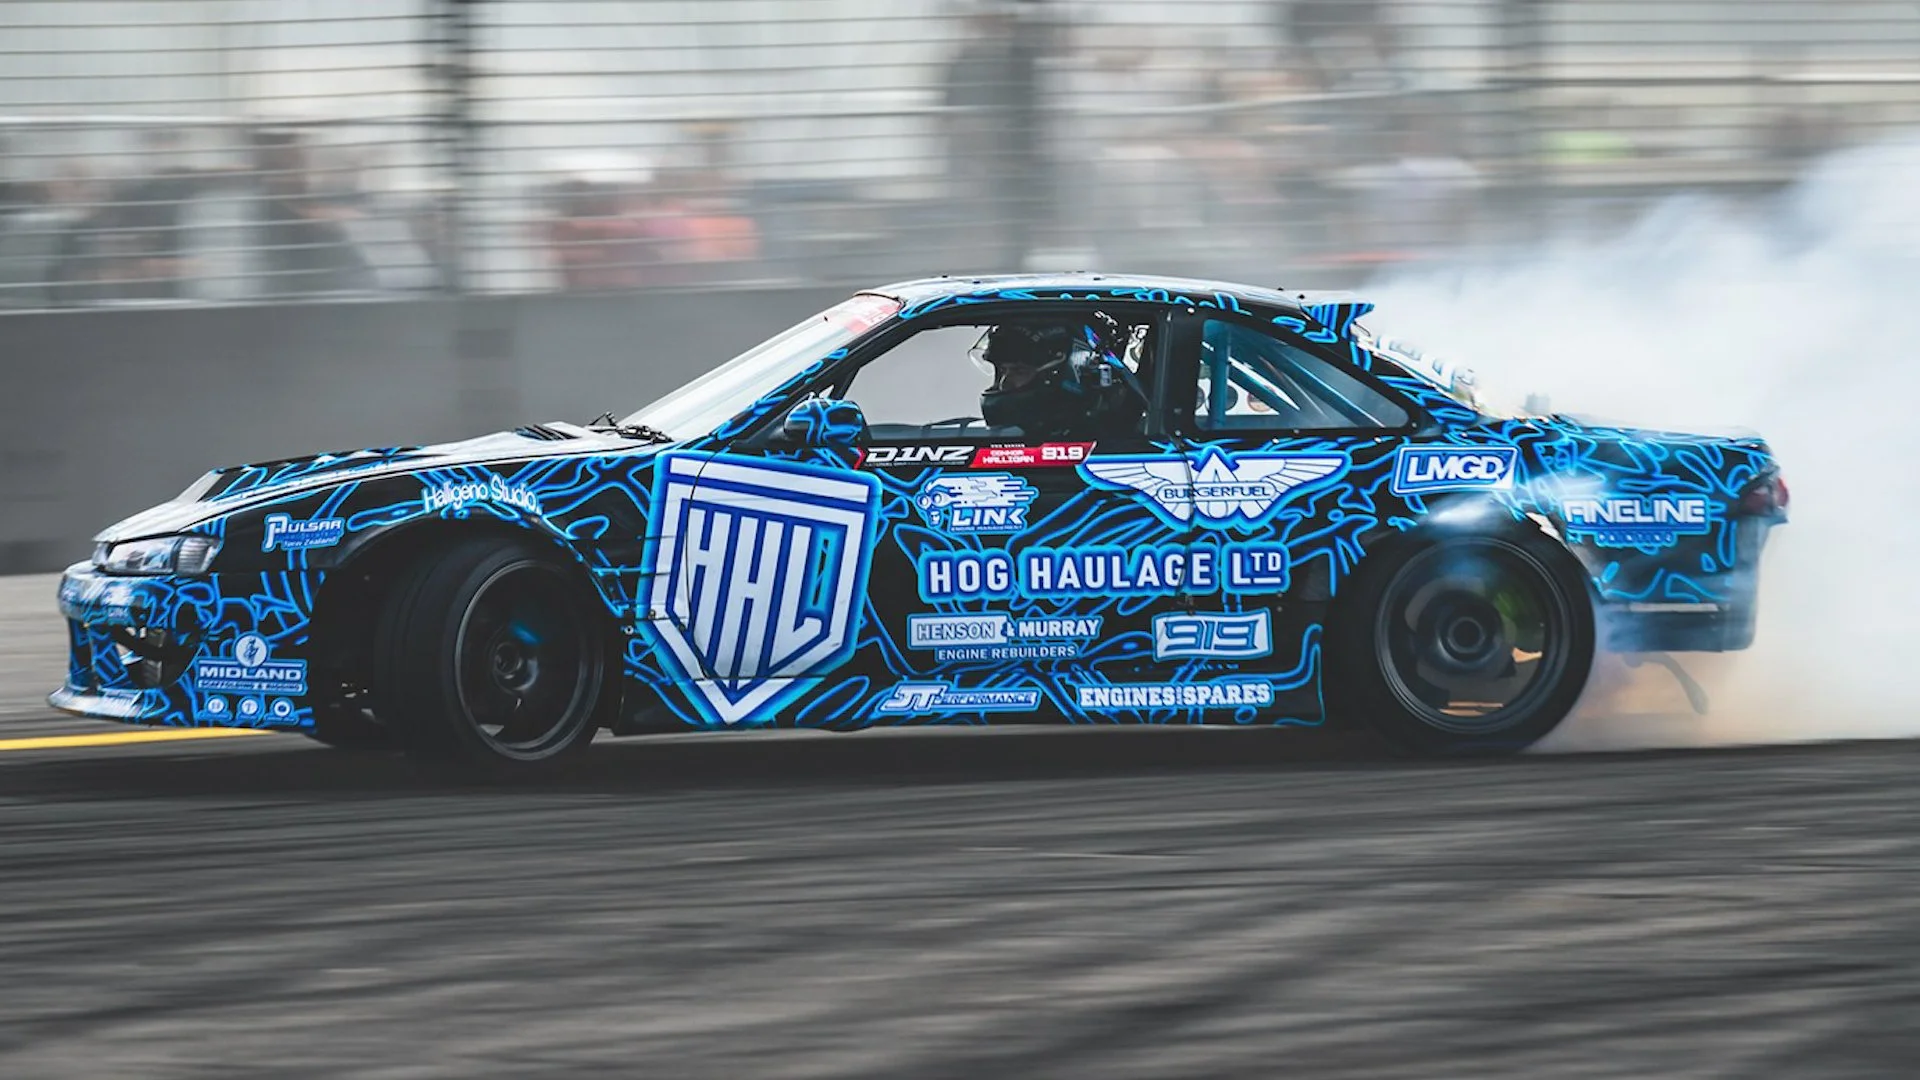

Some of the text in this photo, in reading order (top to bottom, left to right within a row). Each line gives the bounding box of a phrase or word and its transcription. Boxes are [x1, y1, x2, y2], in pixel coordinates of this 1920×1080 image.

[866, 446, 975, 462] D1NZ
[1407, 455, 1505, 482] LMGD
[1164, 486, 1270, 499] BURGERFUEL
[952, 508, 1024, 526] LINK
[265, 516, 341, 548] PULSAR
[930, 558, 1009, 593] HOG
[1031, 553, 1211, 589] HAULAGE
[673, 508, 822, 690] HHL
[917, 623, 995, 640] HENSON
[1019, 620, 1099, 636] MURRAY
[939, 646, 1075, 660] ENGINE REBUILDERS
[200, 667, 301, 680] MIDLAND
[1080, 686, 1175, 707] ENGINES
[1184, 684, 1271, 706] SPARES
